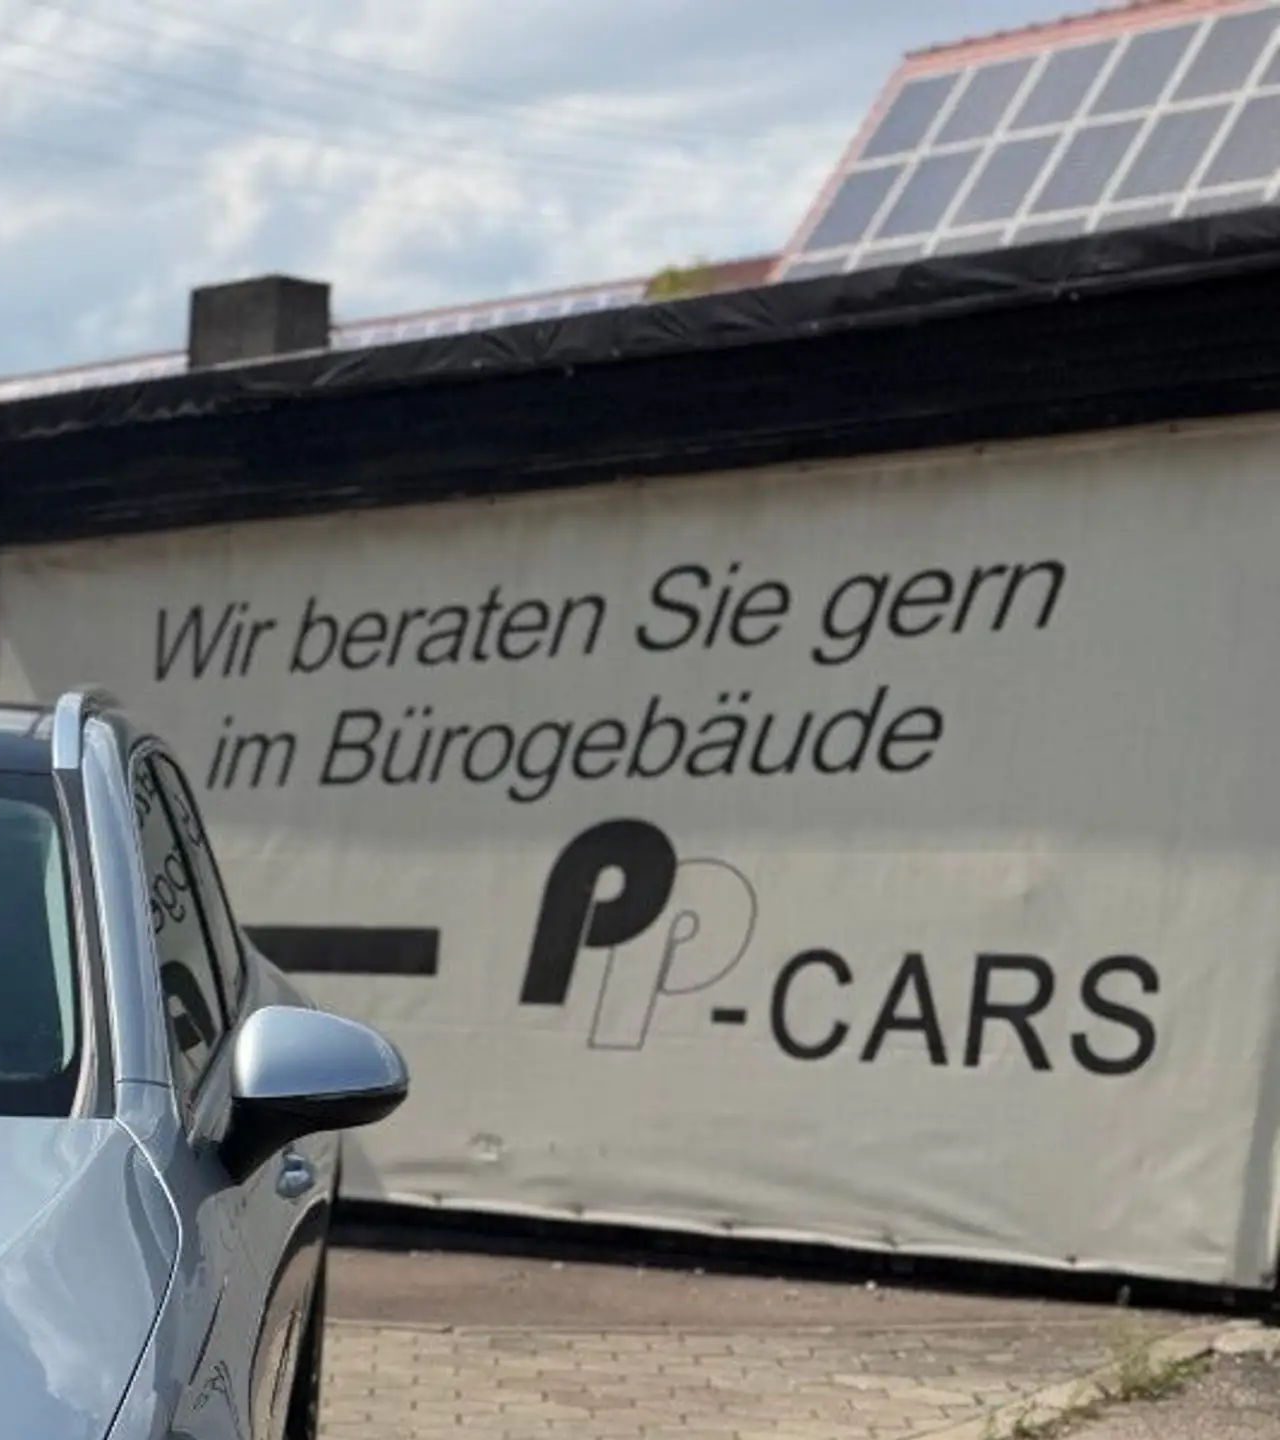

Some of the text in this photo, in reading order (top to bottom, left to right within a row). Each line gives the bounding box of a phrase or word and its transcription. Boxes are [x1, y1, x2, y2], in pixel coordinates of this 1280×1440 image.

[154, 559, 1066, 682] Wir beraten Sie gern
[206, 685, 944, 804] im Bürogebäude
